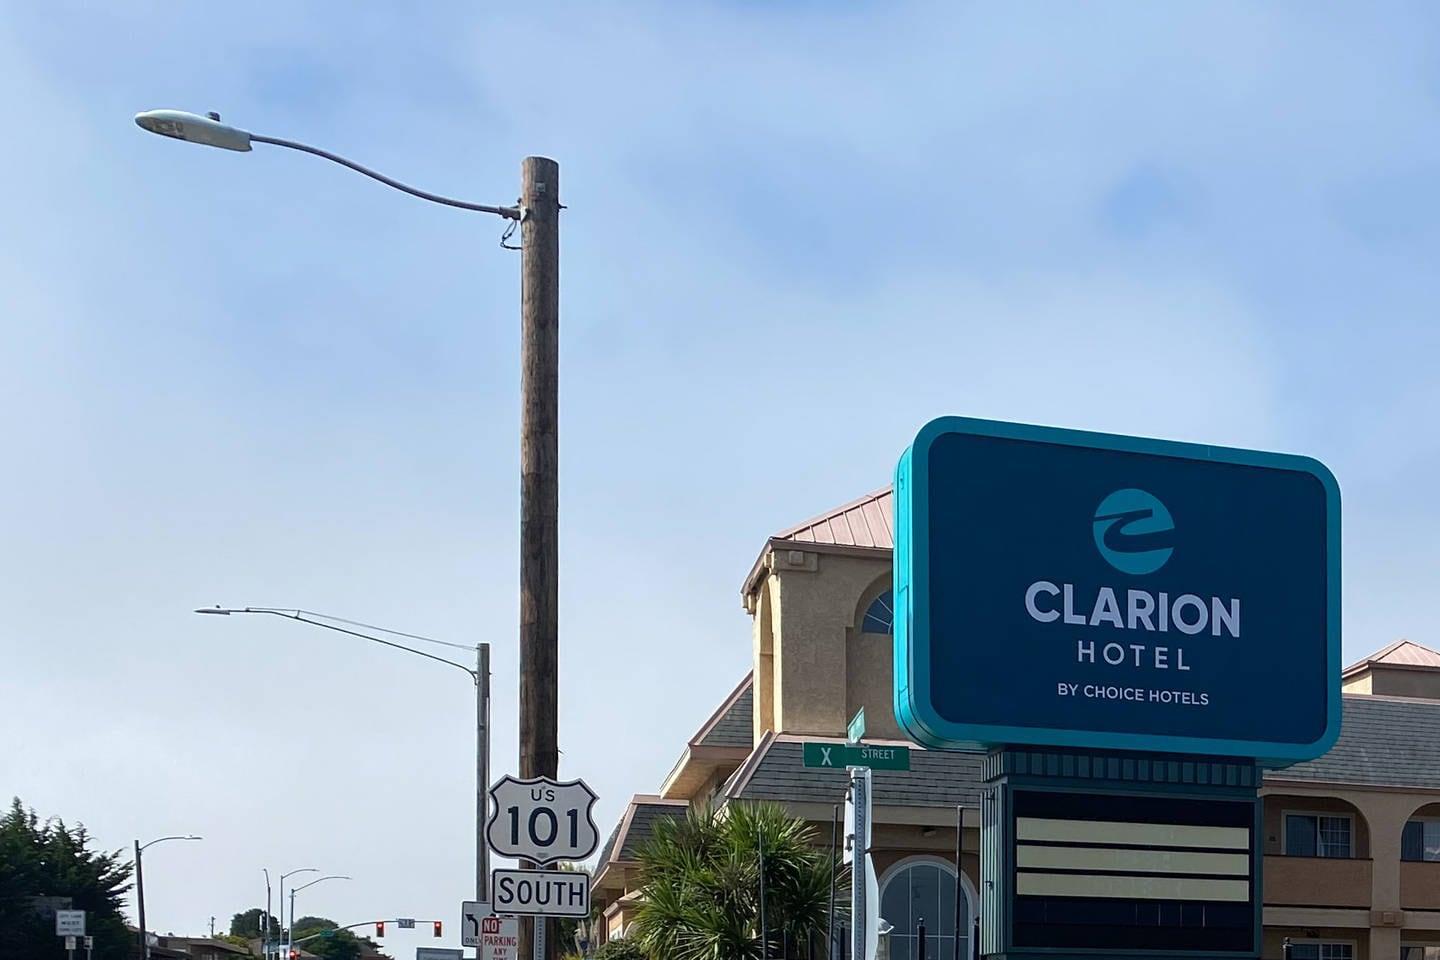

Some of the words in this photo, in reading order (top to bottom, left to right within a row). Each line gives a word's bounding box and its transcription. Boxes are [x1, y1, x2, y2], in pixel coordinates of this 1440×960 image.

[1024, 580, 1241, 638] CLARION
[1077, 640, 1191, 671] HOTEL
[1056, 682, 1079, 697] BY
[1083, 684, 1145, 702] CHOICE
[1148, 689, 1210, 706] HOTELS
[820, 747, 833, 766] X
[861, 749, 895, 760] STREET
[530, 788, 556, 802] US
[507, 805, 579, 849] 101
[497, 876, 585, 907] SOUTH
[483, 919, 498, 932] NO
[484, 936, 517, 946] PARKING
[493, 947, 507, 956] ANY
